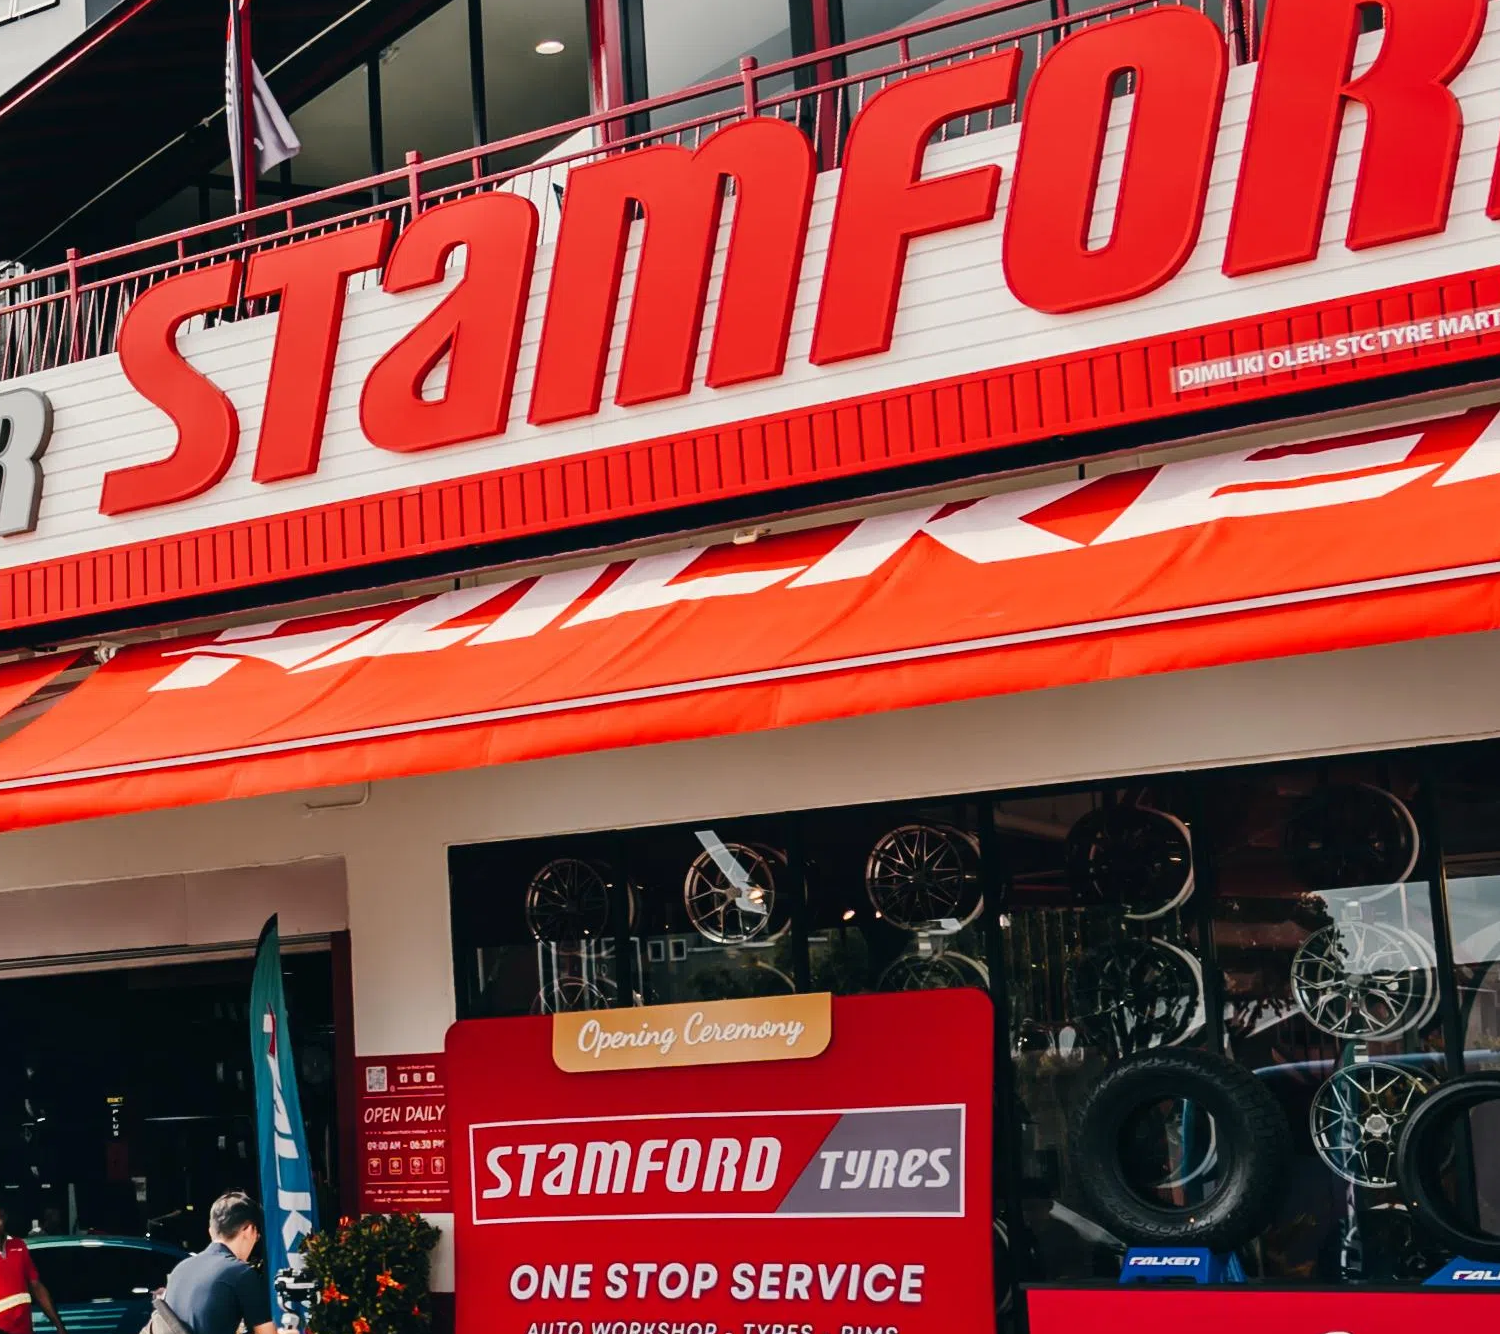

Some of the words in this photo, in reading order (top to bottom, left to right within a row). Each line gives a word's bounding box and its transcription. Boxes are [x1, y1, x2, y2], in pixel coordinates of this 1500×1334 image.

[1177, 352, 1265, 388] DIMILIKI
[1268, 342, 1333, 371] OLEH:
[1335, 332, 1377, 360] STC
[1377, 322, 1433, 352] TYRE
[578, 1018, 677, 1058] Opening
[683, 1011, 805, 1051] Ceremony
[364, 1106, 400, 1124] OPEN
[405, 1104, 446, 1122] DAILY
[1128, 1255, 1202, 1267] FALKEN
[509, 1263, 593, 1301] ONE
[605, 1262, 719, 1300] STOP
[729, 1263, 926, 1304] SERVICE
